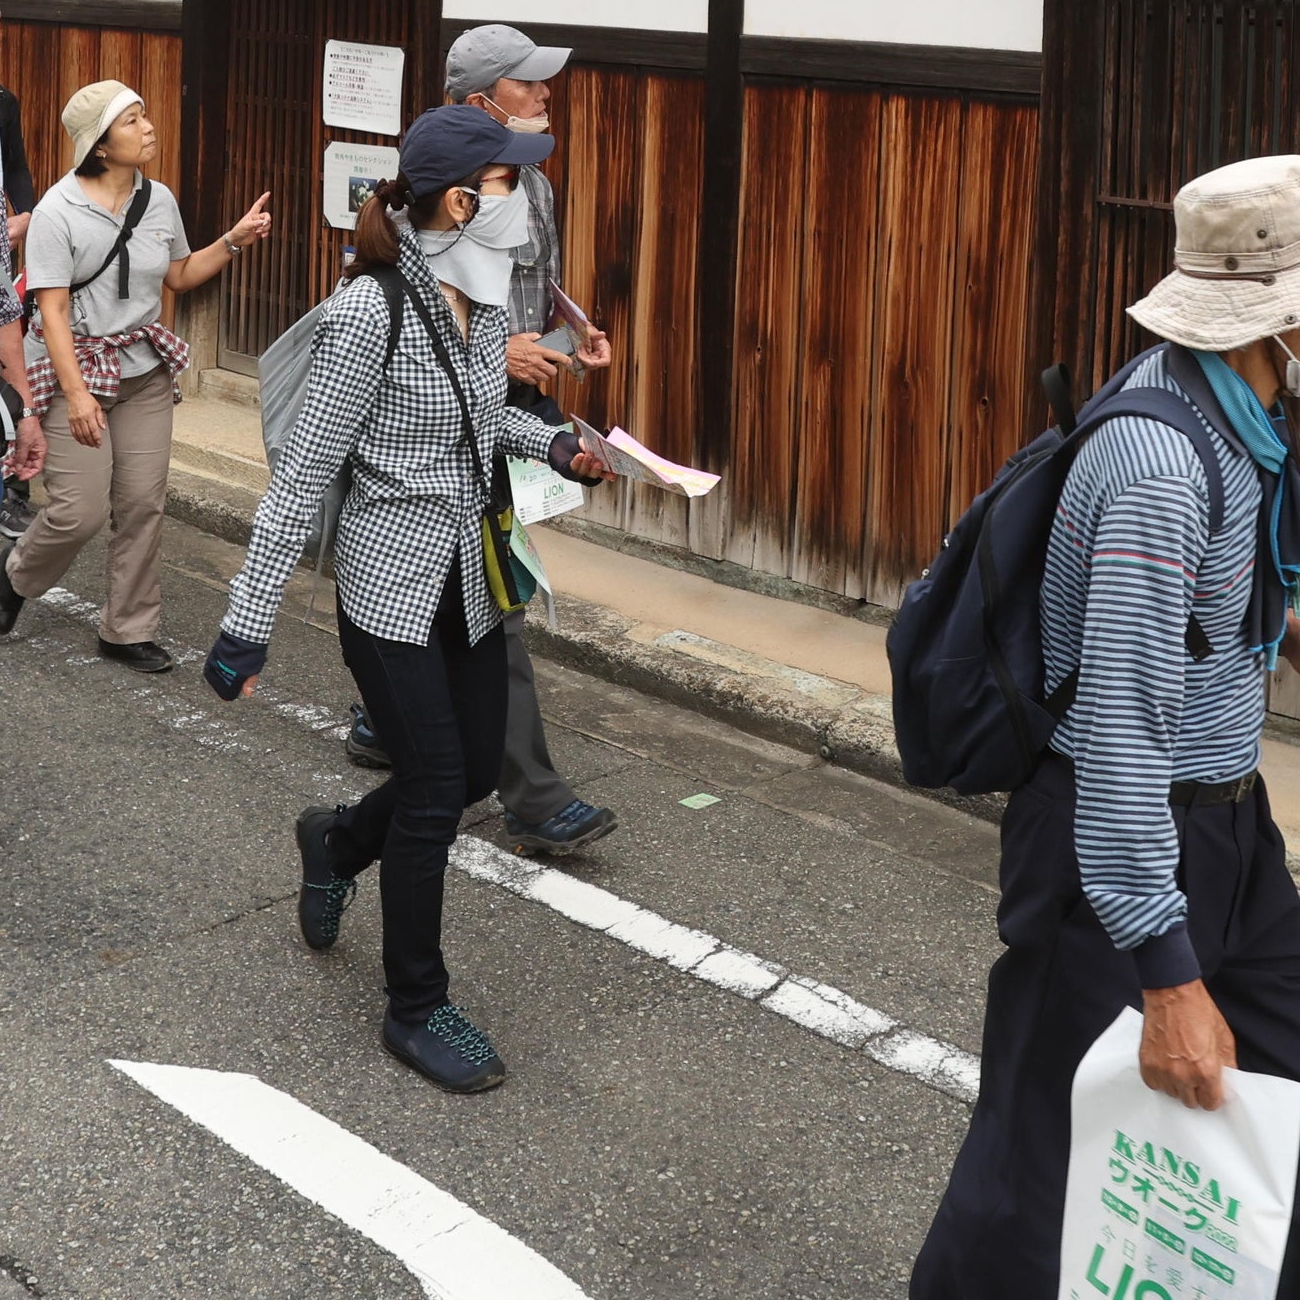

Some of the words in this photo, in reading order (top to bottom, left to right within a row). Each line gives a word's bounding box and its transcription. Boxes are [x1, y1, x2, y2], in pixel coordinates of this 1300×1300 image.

[543, 482, 565, 499] LION
[1108, 1156, 1209, 1232] ウオーク
[1111, 1129, 1243, 1226] KANSAI
